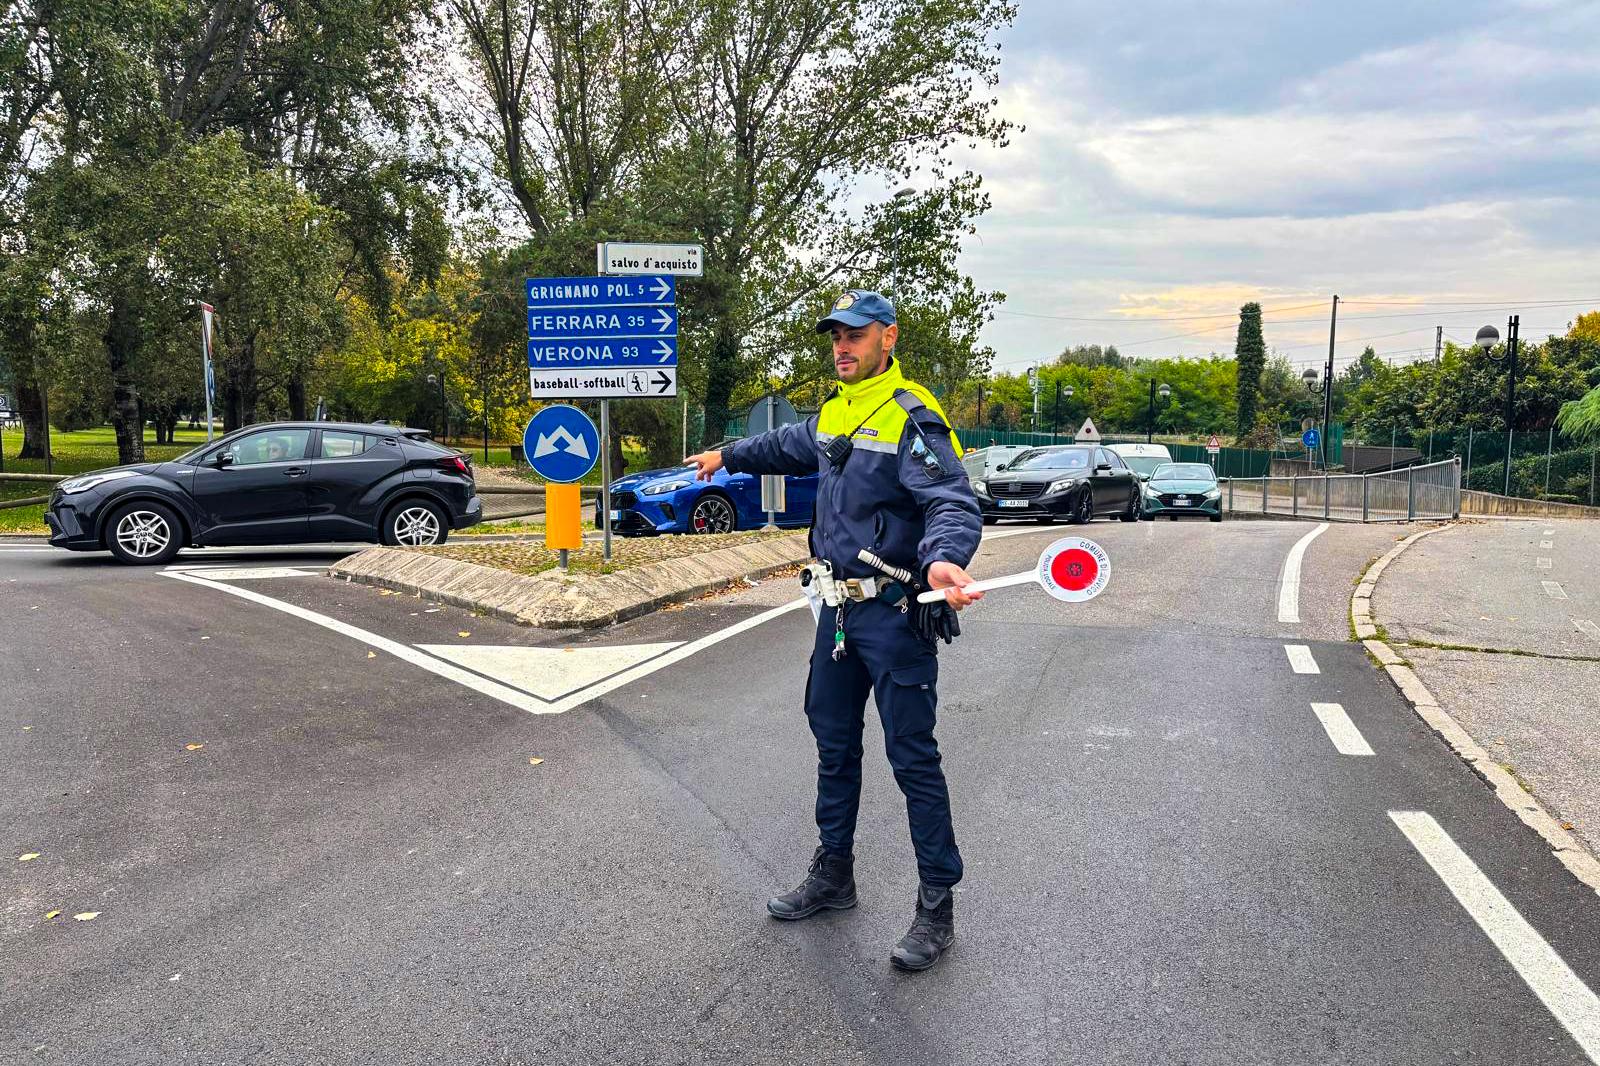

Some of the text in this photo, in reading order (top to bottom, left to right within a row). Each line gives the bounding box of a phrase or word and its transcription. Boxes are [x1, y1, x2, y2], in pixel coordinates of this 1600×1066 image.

[611, 257, 639, 268] salvo
[531, 284, 645, 299] GRIGNANO POL. 5
[532, 314, 646, 330] FERRARA 35
[533, 345, 639, 362] VERONA 93
[534, 376, 626, 389] baseball-softball
[1080, 541, 1106, 562] COMUNE
